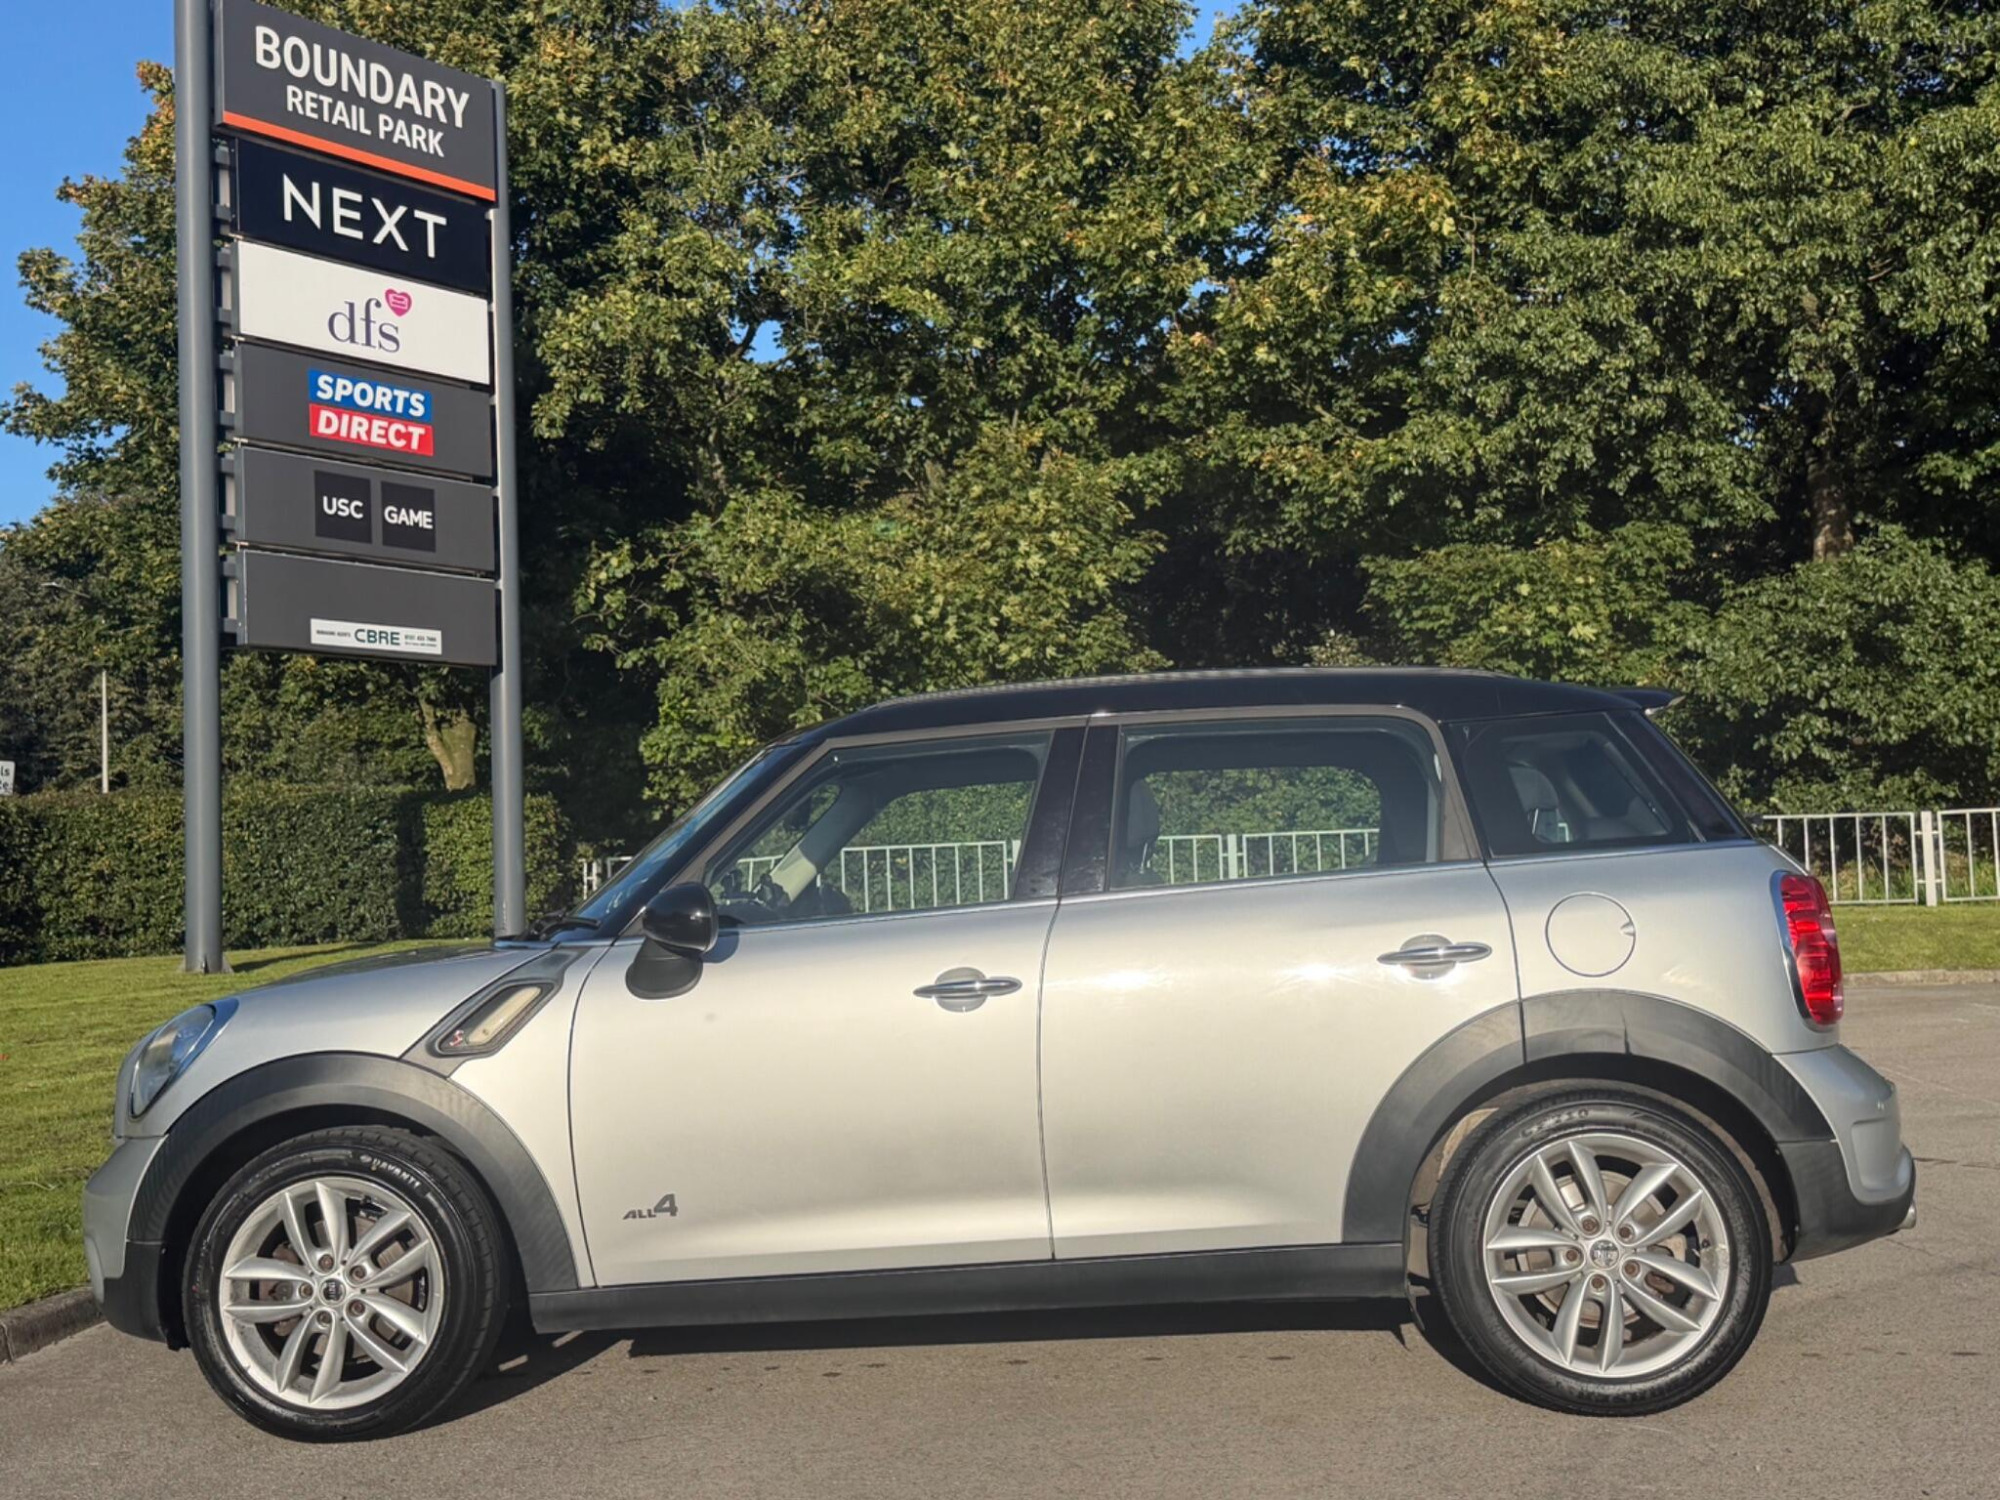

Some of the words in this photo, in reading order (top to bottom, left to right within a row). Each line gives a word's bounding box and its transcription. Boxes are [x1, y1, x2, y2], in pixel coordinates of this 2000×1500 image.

[255, 26, 469, 128] BOUNDARY
[286, 85, 371, 135] RETAIL
[379, 113, 444, 157] PARK
[283, 173, 447, 258] NEXT
[328, 298, 400, 353] dfs
[316, 374, 425, 417] SPORTS
[317, 409, 425, 450] DIRECT
[322, 495, 364, 518] USC
[384, 505, 433, 529] GAME
[354, 628, 401, 646] CBRE
